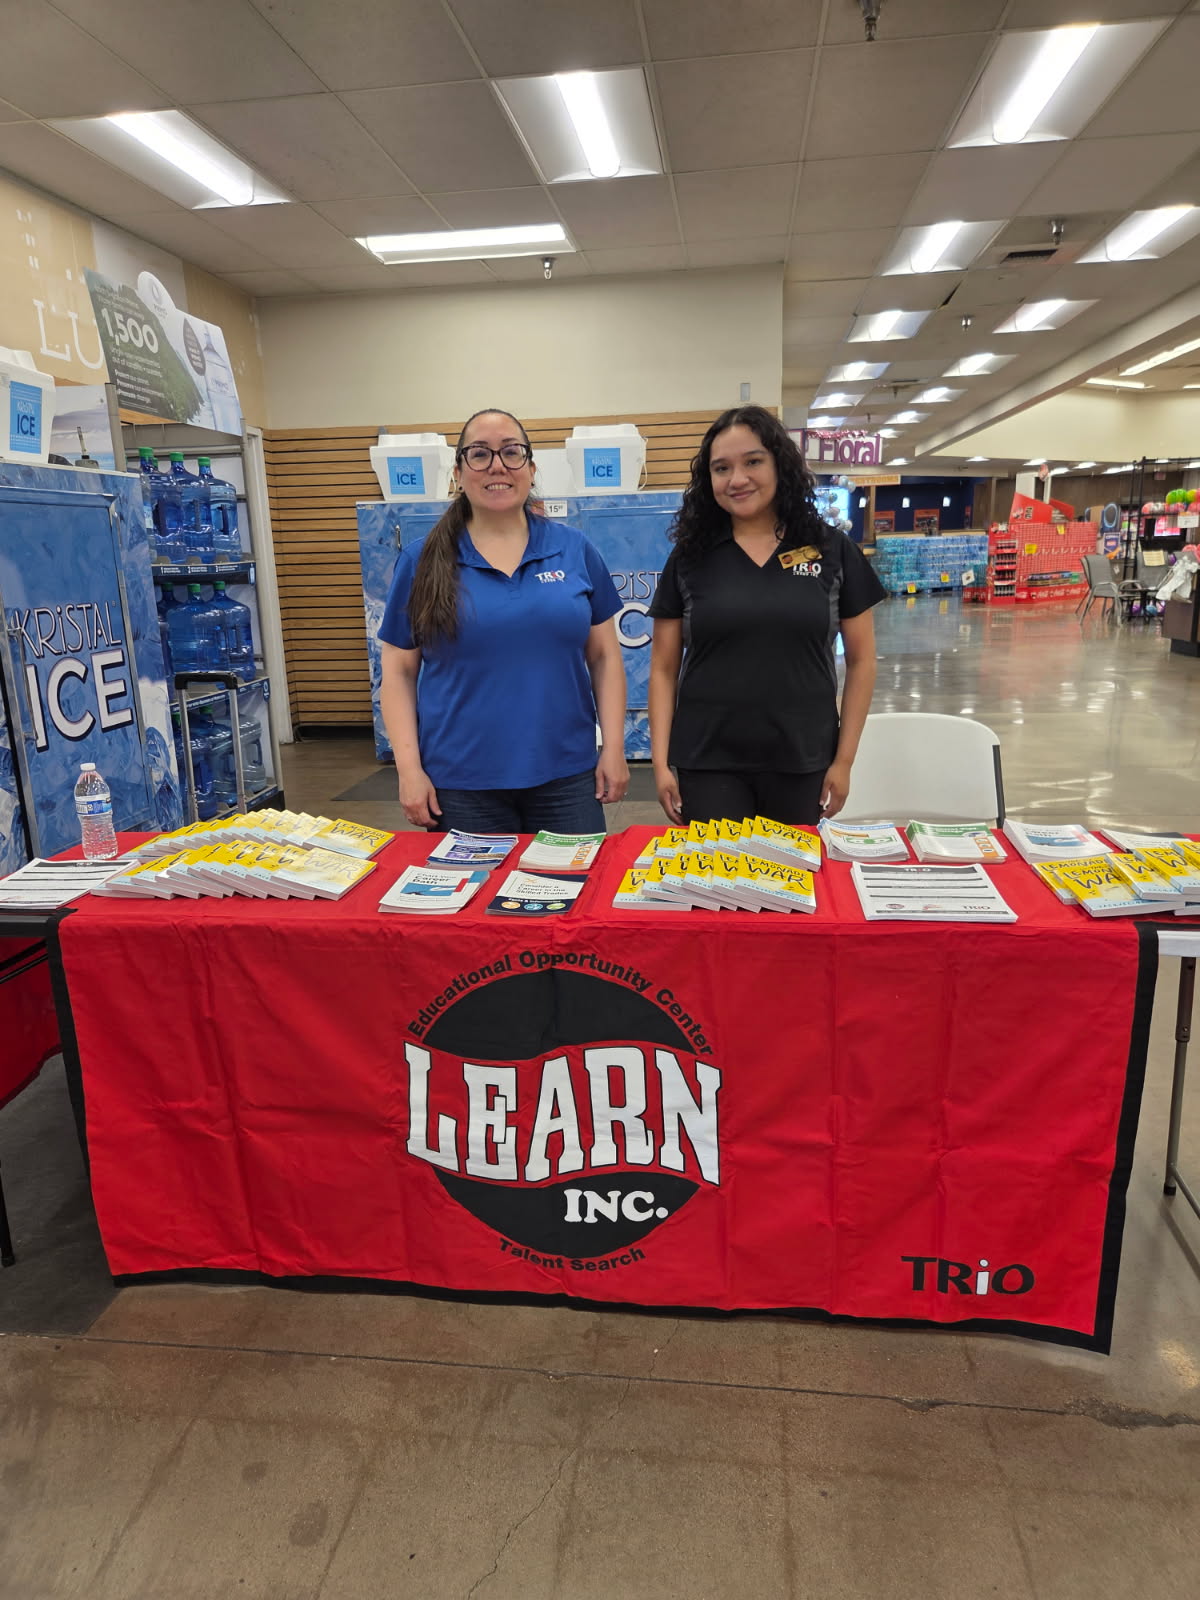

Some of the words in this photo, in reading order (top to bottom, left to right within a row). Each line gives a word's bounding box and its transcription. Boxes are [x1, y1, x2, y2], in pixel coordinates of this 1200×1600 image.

[101, 307, 159, 354] 1,500
[17, 414, 36, 436] ICE
[819, 434, 881, 465] Floral
[396, 473, 417, 486] ICE
[592, 465, 613, 478] ICE
[610, 571, 663, 600] RiST
[26, 648, 134, 753] ICE
[330, 826, 380, 848] WAR
[762, 824, 817, 852] WAR
[304, 856, 358, 880] WAR
[745, 856, 807, 879] LEMONADE
[748, 863, 813, 891] WAR
[1041, 858, 1104, 872] LEMONAD
[1063, 868, 1113, 880] LEMON
[1073, 873, 1122, 889] WA
[407, 954, 513, 1038] Educational
[519, 951, 654, 993] Opportunity
[655, 988, 714, 1056] Center
[403, 1040, 722, 1187] LEARN
[563, 1188, 669, 1224] INC.
[500, 1239, 564, 1270] Talent
[570, 1247, 646, 1272] Search
[901, 1255, 1035, 1296] TRiO
